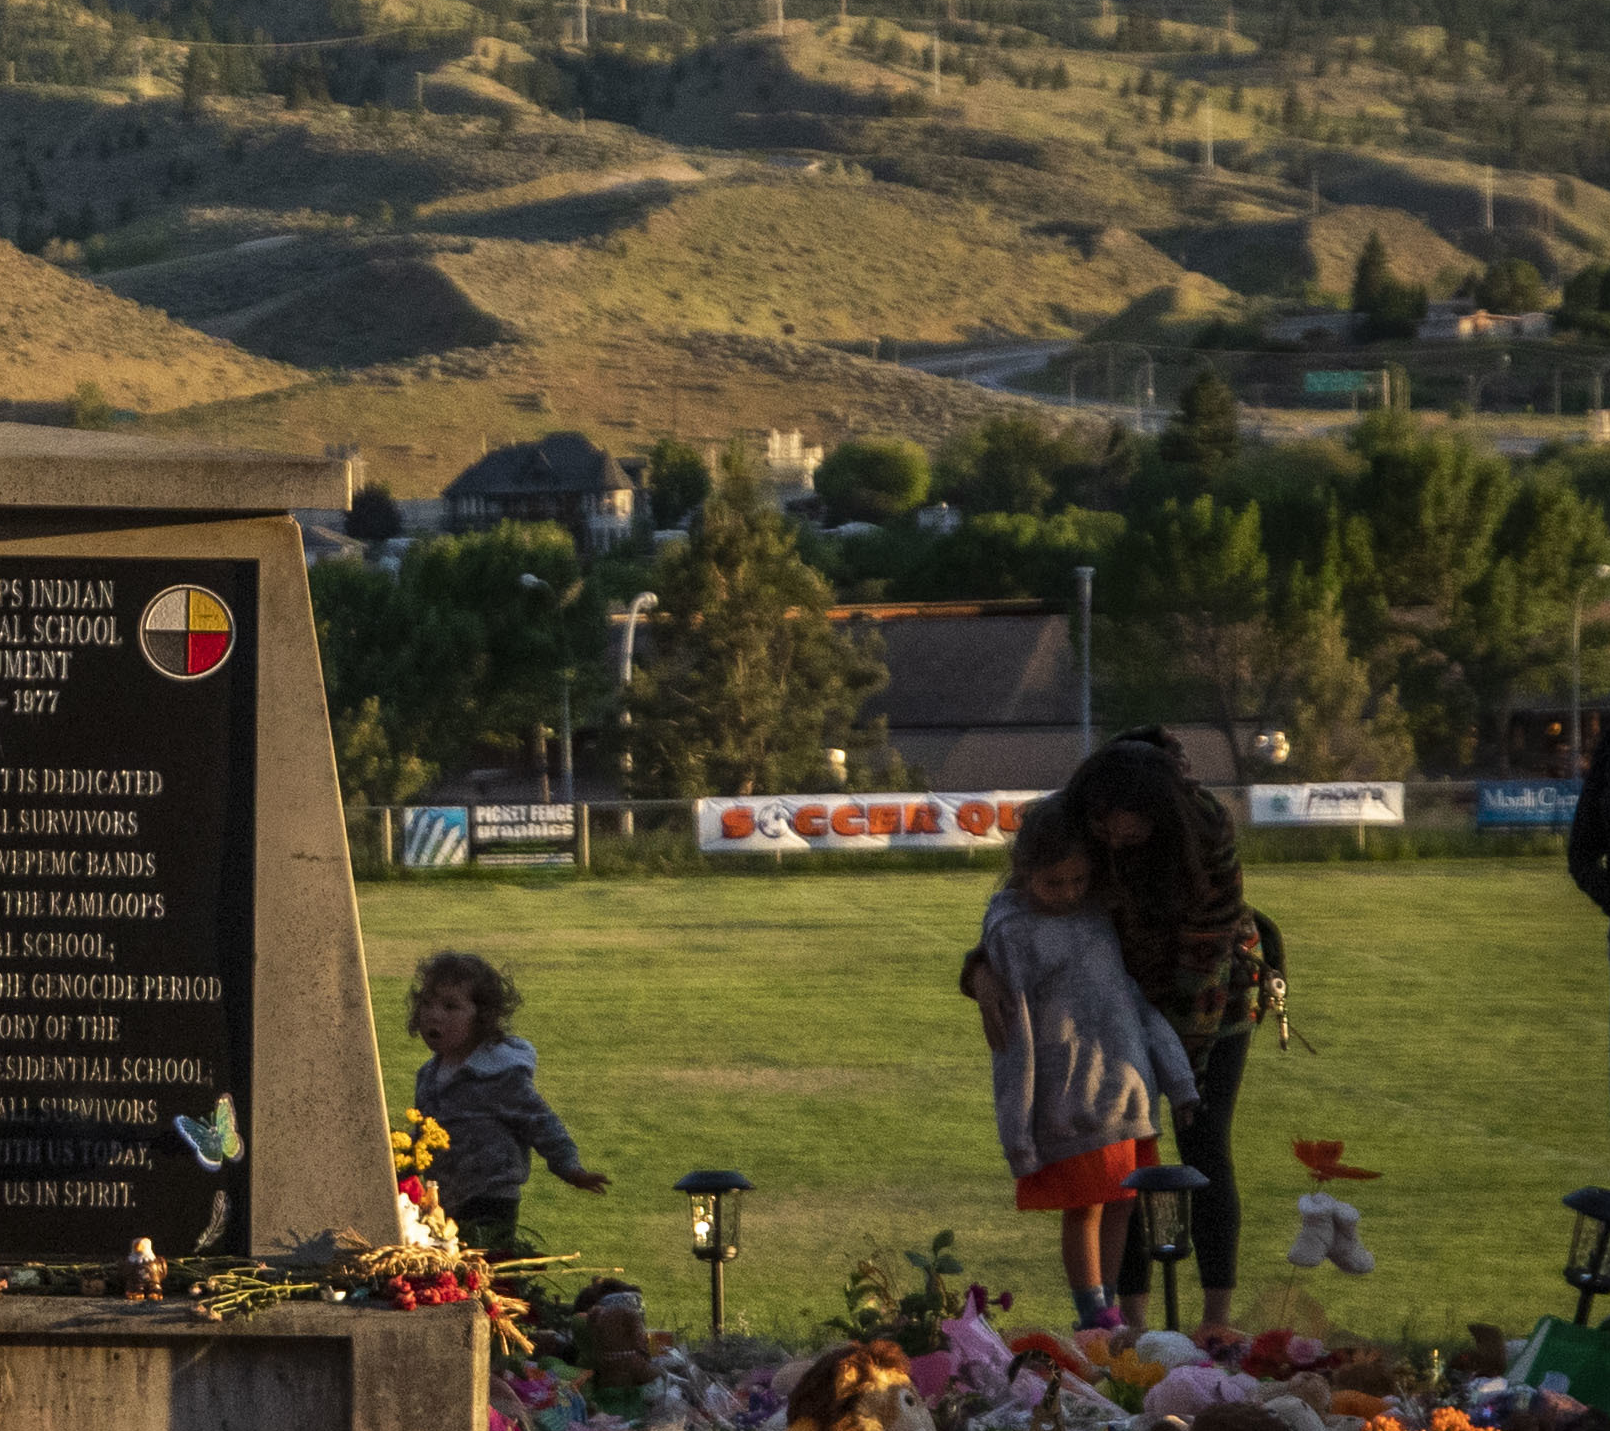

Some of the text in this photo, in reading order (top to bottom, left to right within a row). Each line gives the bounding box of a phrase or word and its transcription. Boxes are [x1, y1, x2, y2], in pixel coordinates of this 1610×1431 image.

[31, 579, 114, 608] INDIAN
[33, 615, 122, 646] SCHOOL
[14, 690, 59, 714] 1977
[19, 768, 37, 793] IS
[43, 769, 163, 795] DEDICATED
[19, 809, 138, 835] SURVIVORS
[475, 803, 575, 823] PICKET FENCE
[87, 852, 156, 877] BANDS
[2, 891, 44, 916] THE
[50, 892, 165, 918] KAMLOOPS
[32, 974, 138, 1000] GENOCIDE
[144, 975, 222, 1002] PERIOD
[45, 1015, 72, 1040] OF
[77, 1015, 120, 1041] THE
[39, 1097, 157, 1124] SURVIVORS
[48, 1141, 74, 1164] US
[4, 1182, 30, 1205] US
[36, 1181, 57, 1205] IN
